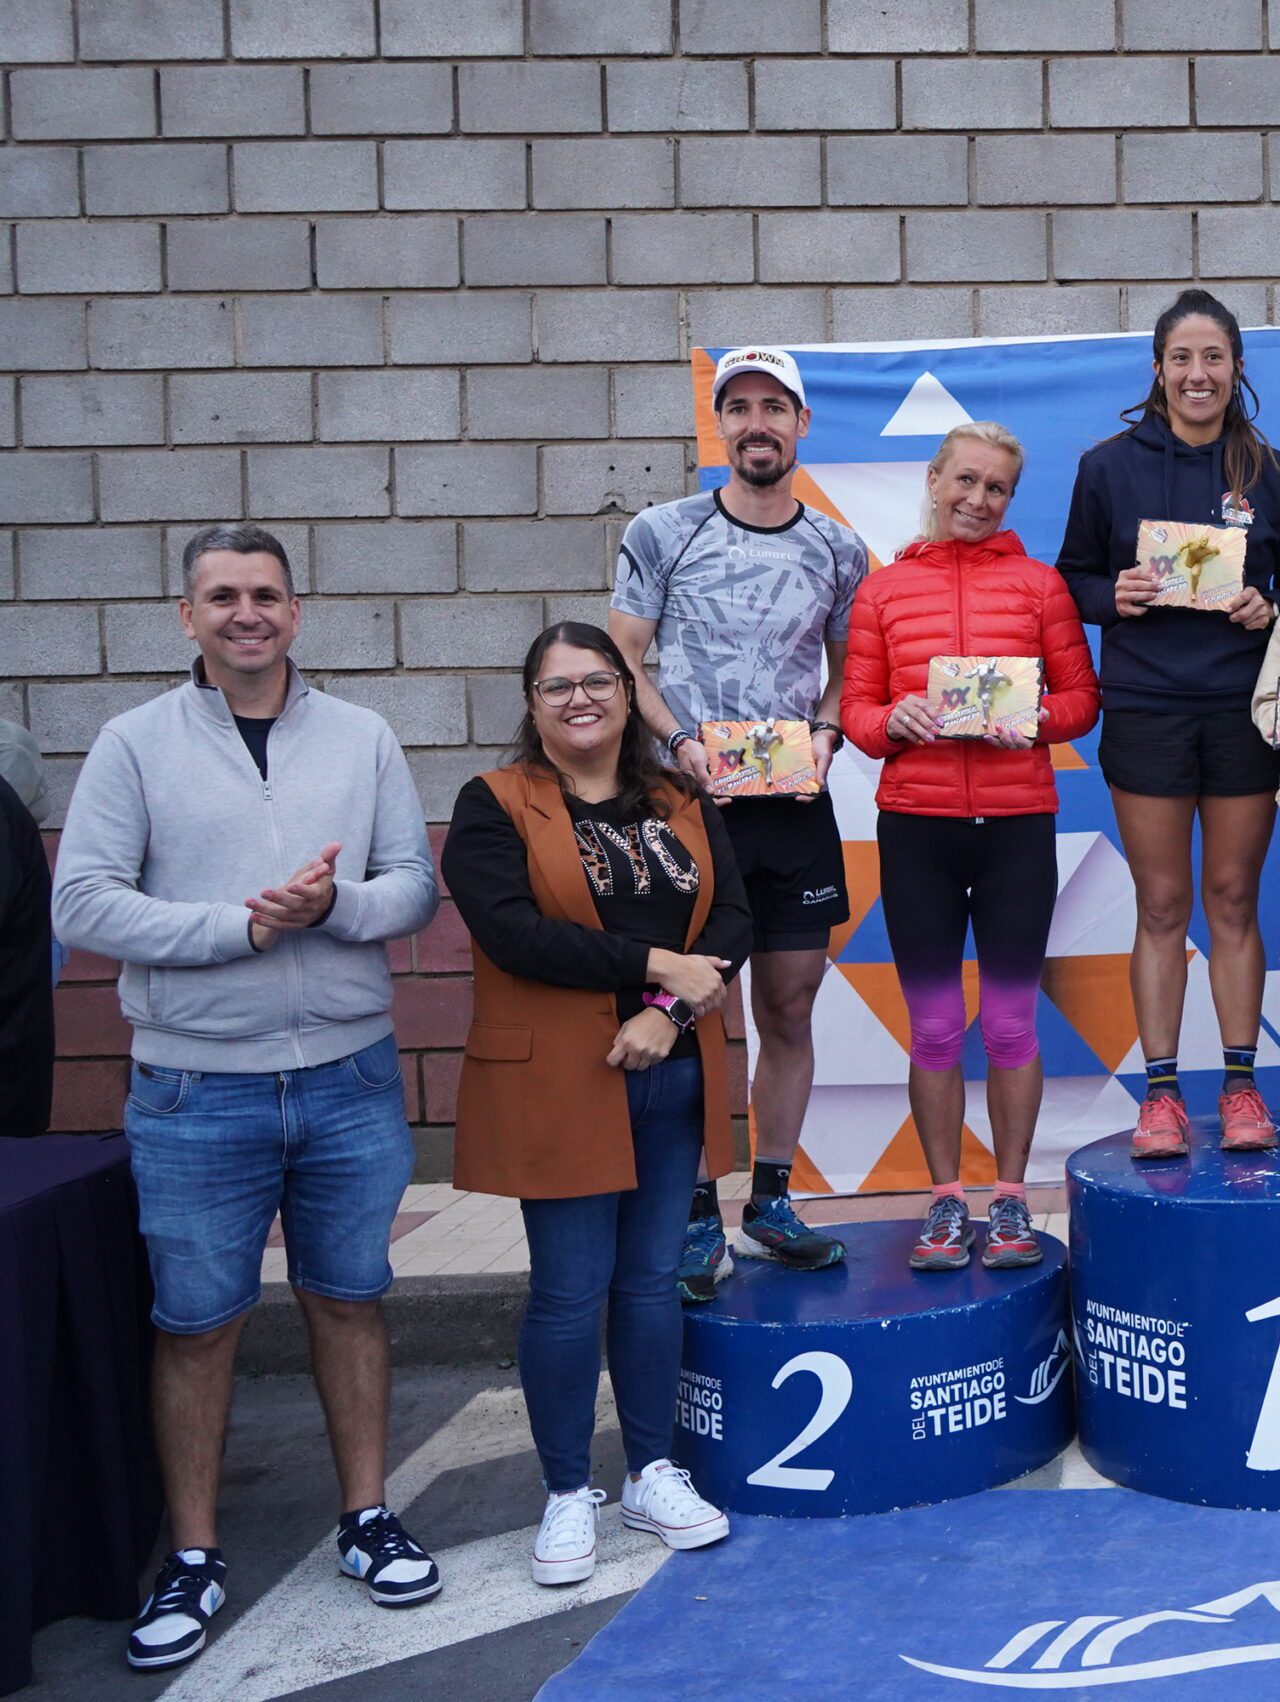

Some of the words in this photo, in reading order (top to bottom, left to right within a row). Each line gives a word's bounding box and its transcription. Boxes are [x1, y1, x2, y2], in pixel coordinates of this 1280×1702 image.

[1087, 1318, 1185, 1366] SANTIAGO
[1088, 1349, 1098, 1385] DEL
[1098, 1350, 1187, 1409] TEIDE
[678, 1381, 722, 1411] NTIAGO
[910, 1371, 1005, 1410] SANTIAGO
[746, 1351, 853, 1491] 2
[912, 1411, 926, 1440] DEL
[927, 1391, 1007, 1436] TEIDE
